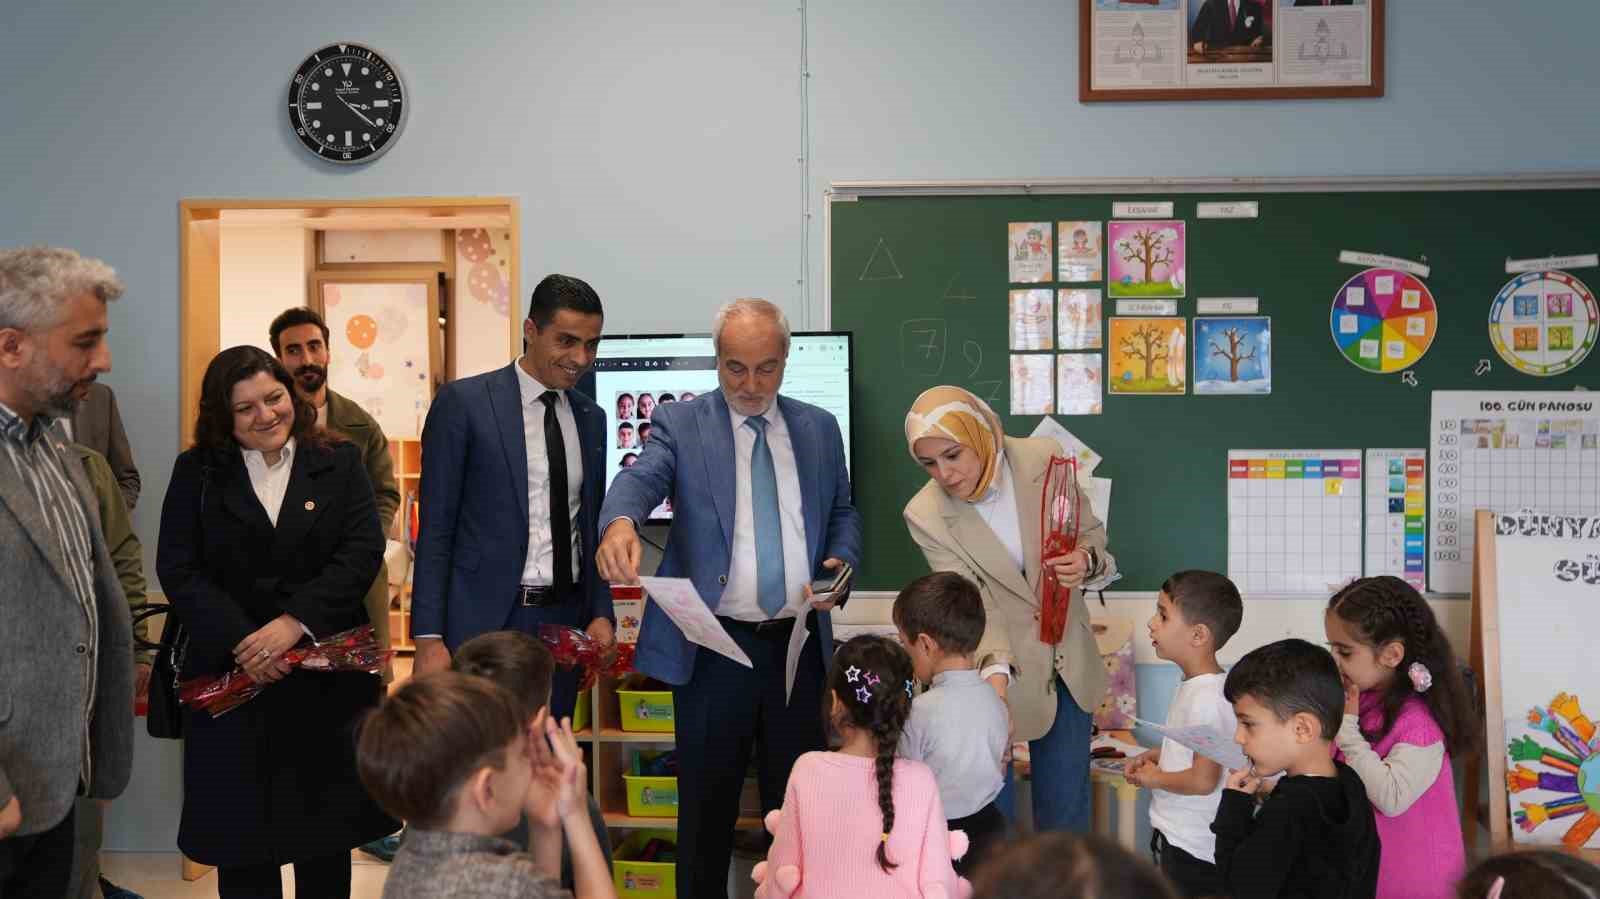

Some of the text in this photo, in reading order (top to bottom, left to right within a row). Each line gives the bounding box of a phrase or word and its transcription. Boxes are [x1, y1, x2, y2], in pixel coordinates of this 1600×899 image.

[912, 329, 938, 359] 7
[1507, 400, 1536, 411] GÜN
[1539, 401, 1593, 412] PANOSU
[1434, 550, 1459, 561] 100
[1553, 553, 1600, 584] GÜ
